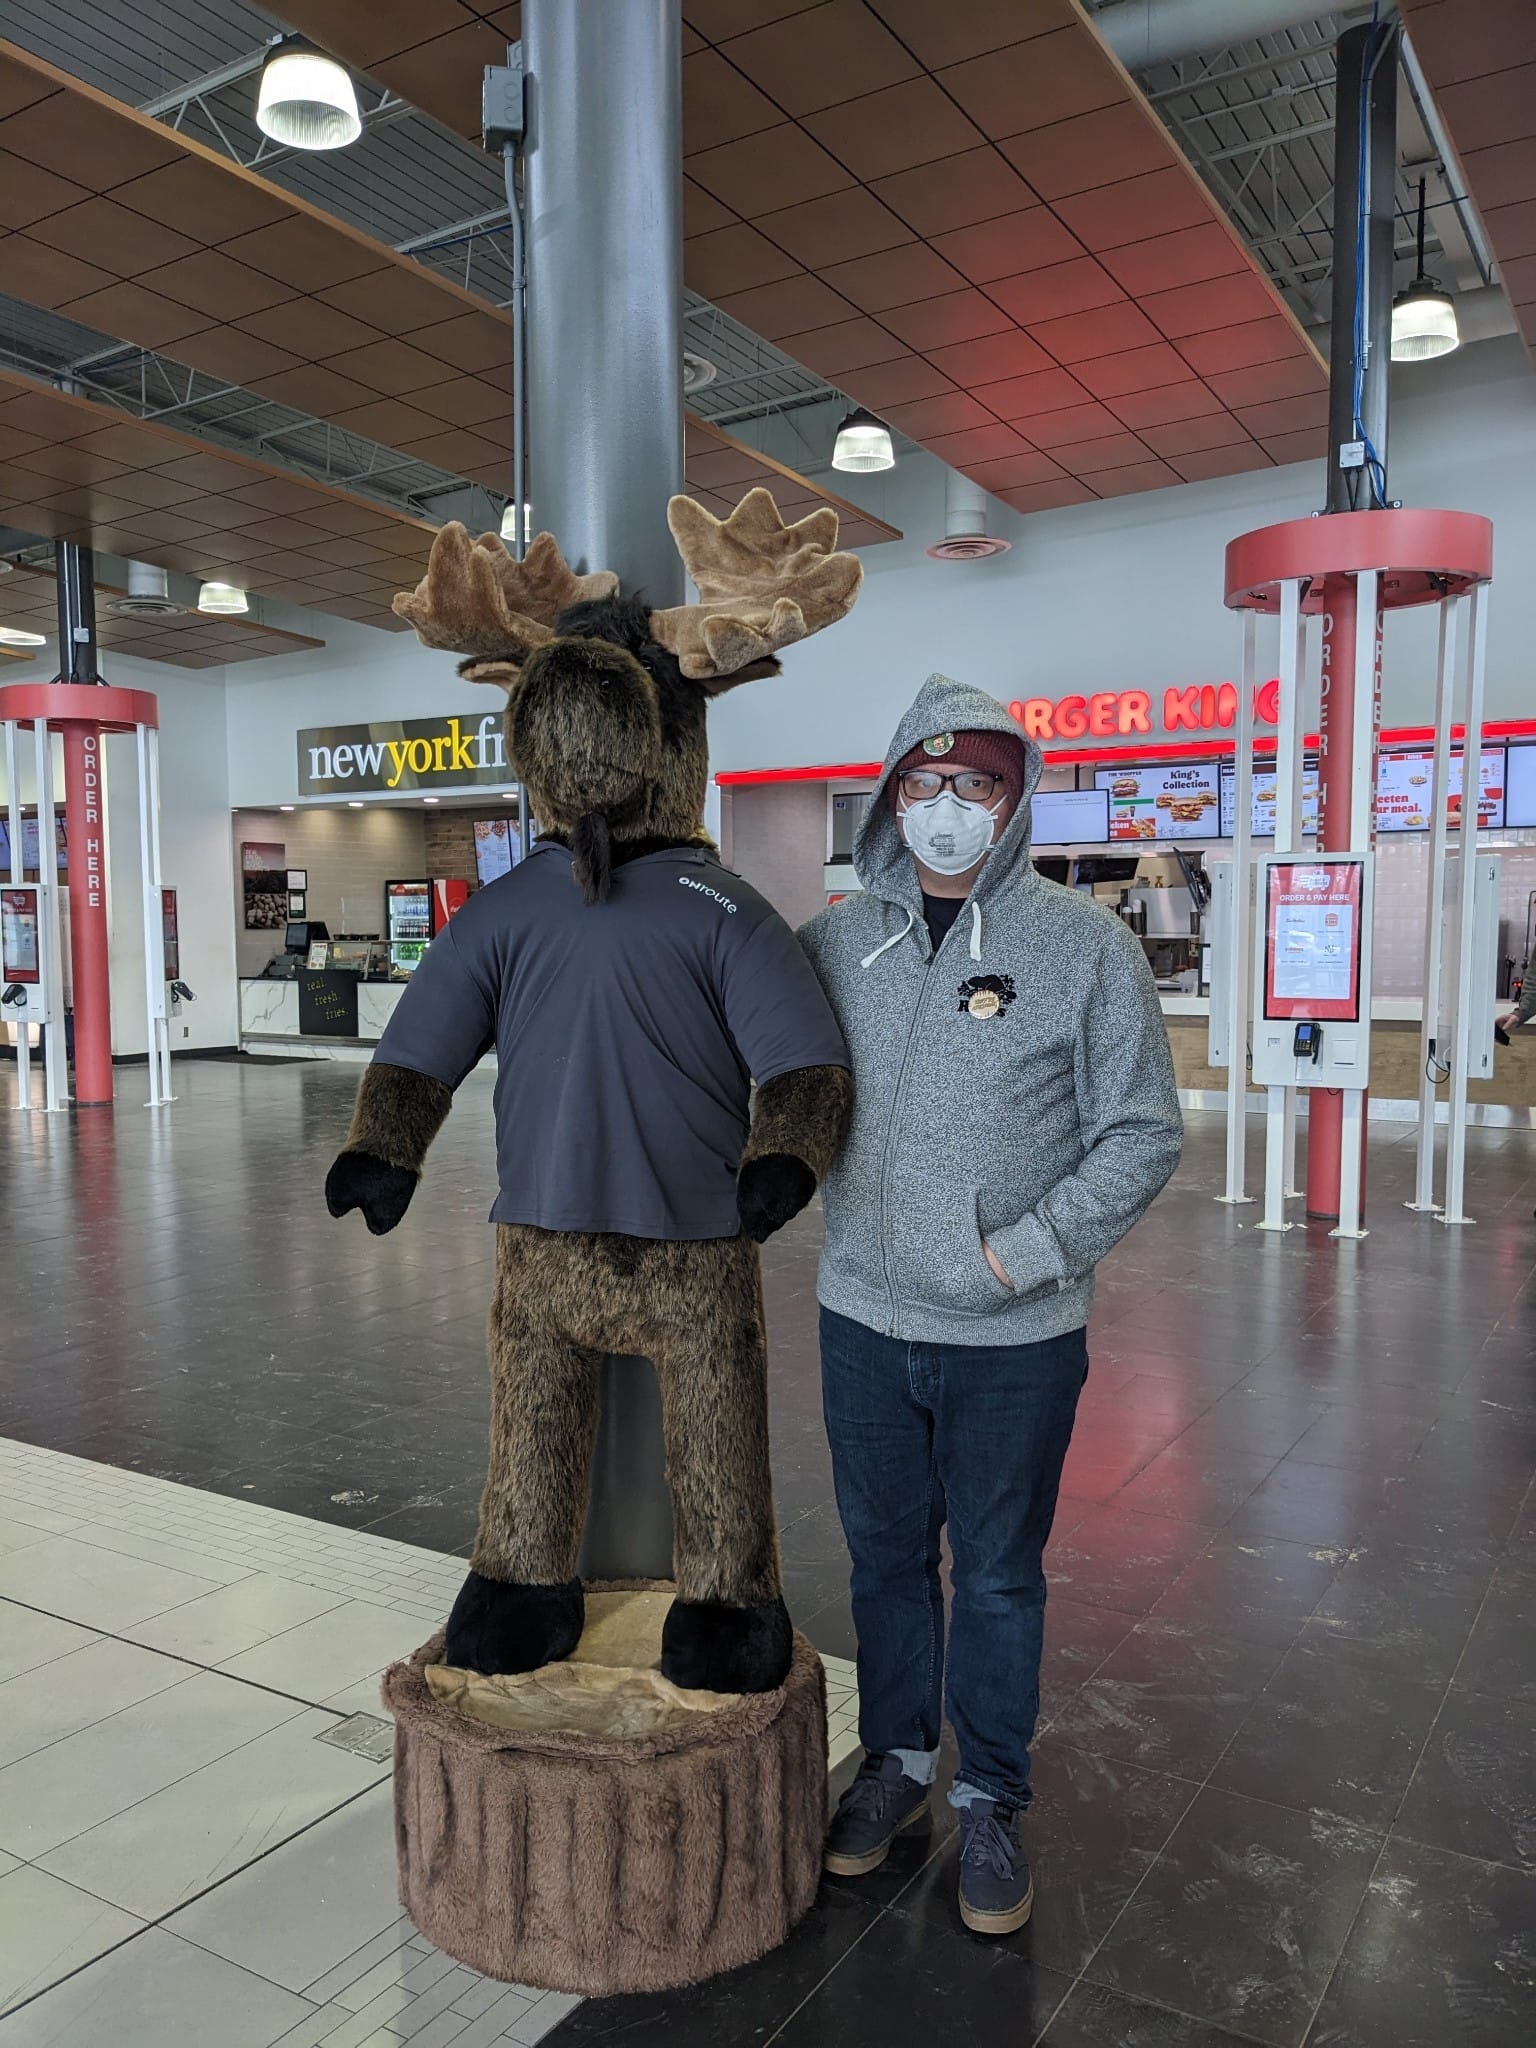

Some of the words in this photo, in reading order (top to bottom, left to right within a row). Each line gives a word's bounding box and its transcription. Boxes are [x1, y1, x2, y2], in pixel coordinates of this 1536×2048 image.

[1009, 690, 1152, 740] RGER
[83, 736, 98, 824] ORDER
[1170, 769, 1200, 780] King's
[1163, 779, 1210, 790] Collection
[1391, 803, 1422, 813] meal.
[87, 838, 100, 907] HERE
[1279, 894, 1305, 902] ORDER
[1313, 894, 1327, 902] PAY
